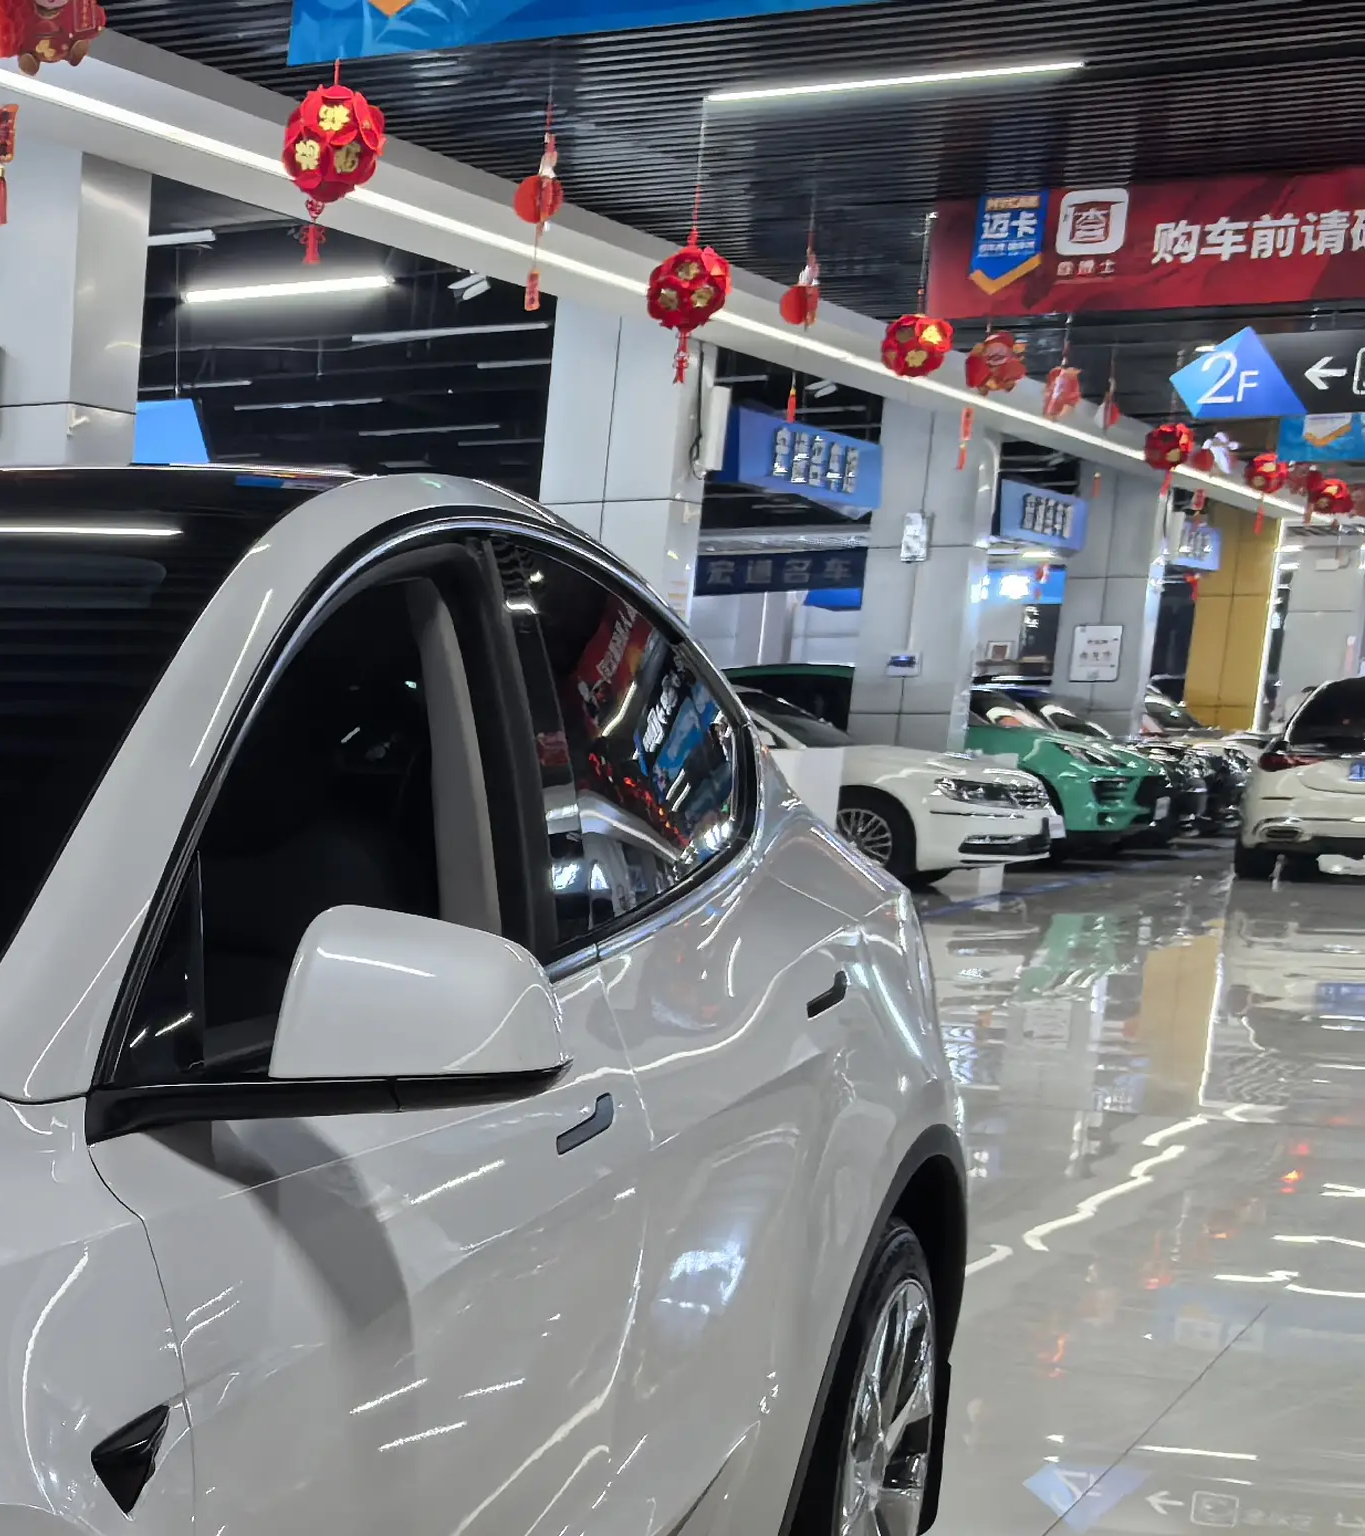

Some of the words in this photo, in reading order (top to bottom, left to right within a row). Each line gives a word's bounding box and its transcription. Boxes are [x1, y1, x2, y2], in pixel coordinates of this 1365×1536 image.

[1197, 351, 1259, 405] 2F
[706, 558, 852, 586] 宏通名车
